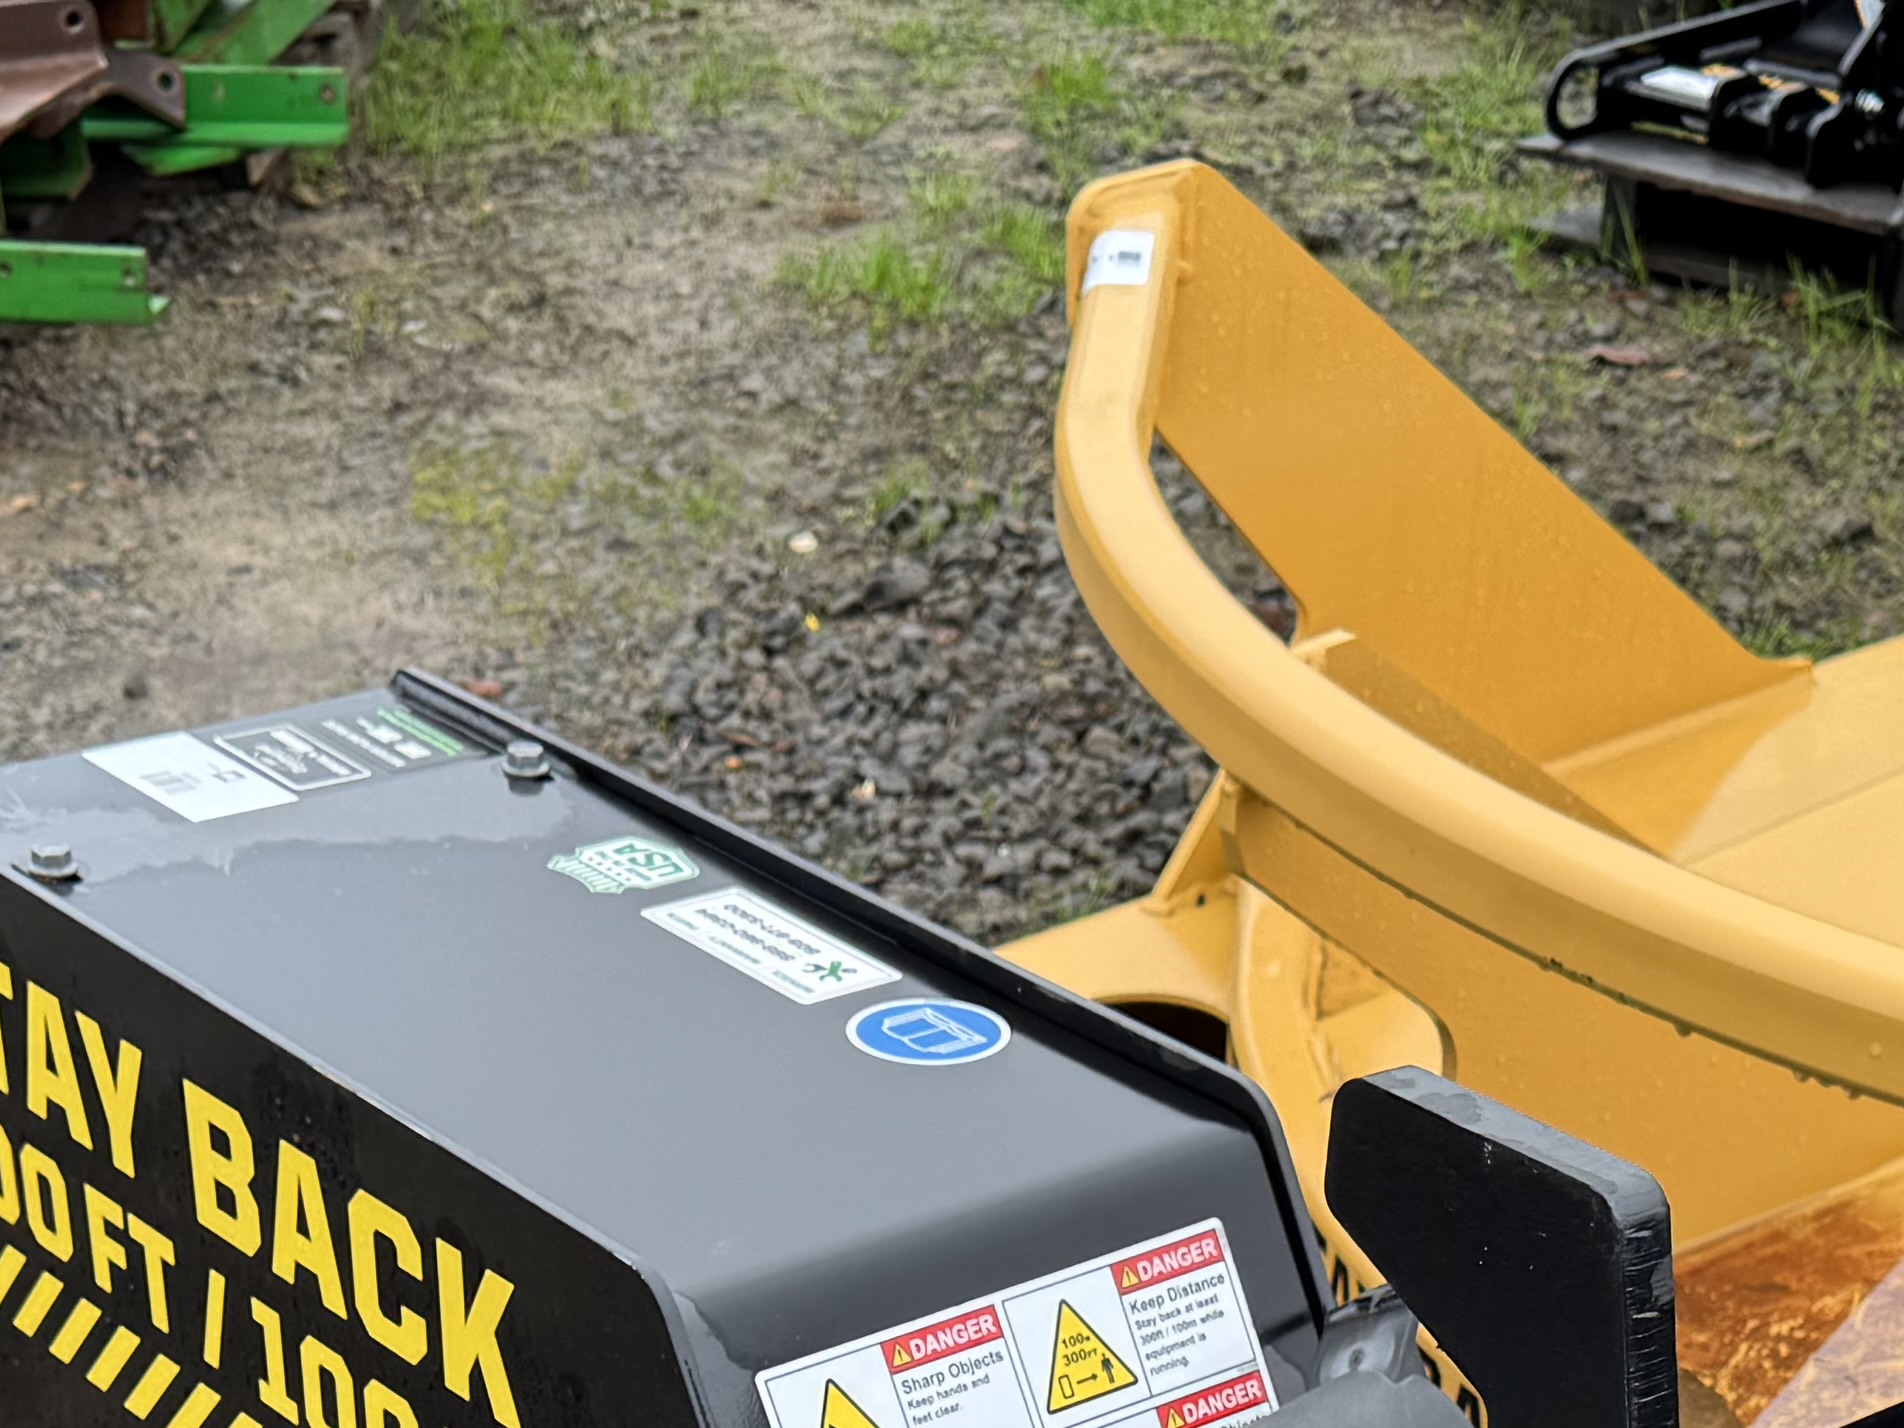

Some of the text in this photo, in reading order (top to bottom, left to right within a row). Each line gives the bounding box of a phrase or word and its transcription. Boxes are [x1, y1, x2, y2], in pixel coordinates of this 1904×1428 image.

[612, 843, 684, 877] USA
[1137, 1238, 1218, 1281] DANGER
[1129, 1273, 1225, 1315] Keep Distance
[1135, 1294, 1220, 1331] Stay back at least
[203, 1268, 226, 1370] /
[909, 1314, 997, 1360] DANGER
[1200, 1310, 1225, 1325] while
[1145, 1333, 1207, 1361] equipment is
[901, 1350, 1004, 1395] Sharp Objects
[907, 1374, 991, 1410] Keep hands and
[912, 1410, 933, 1426] feet
[1182, 1378, 1262, 1424] DANGER
